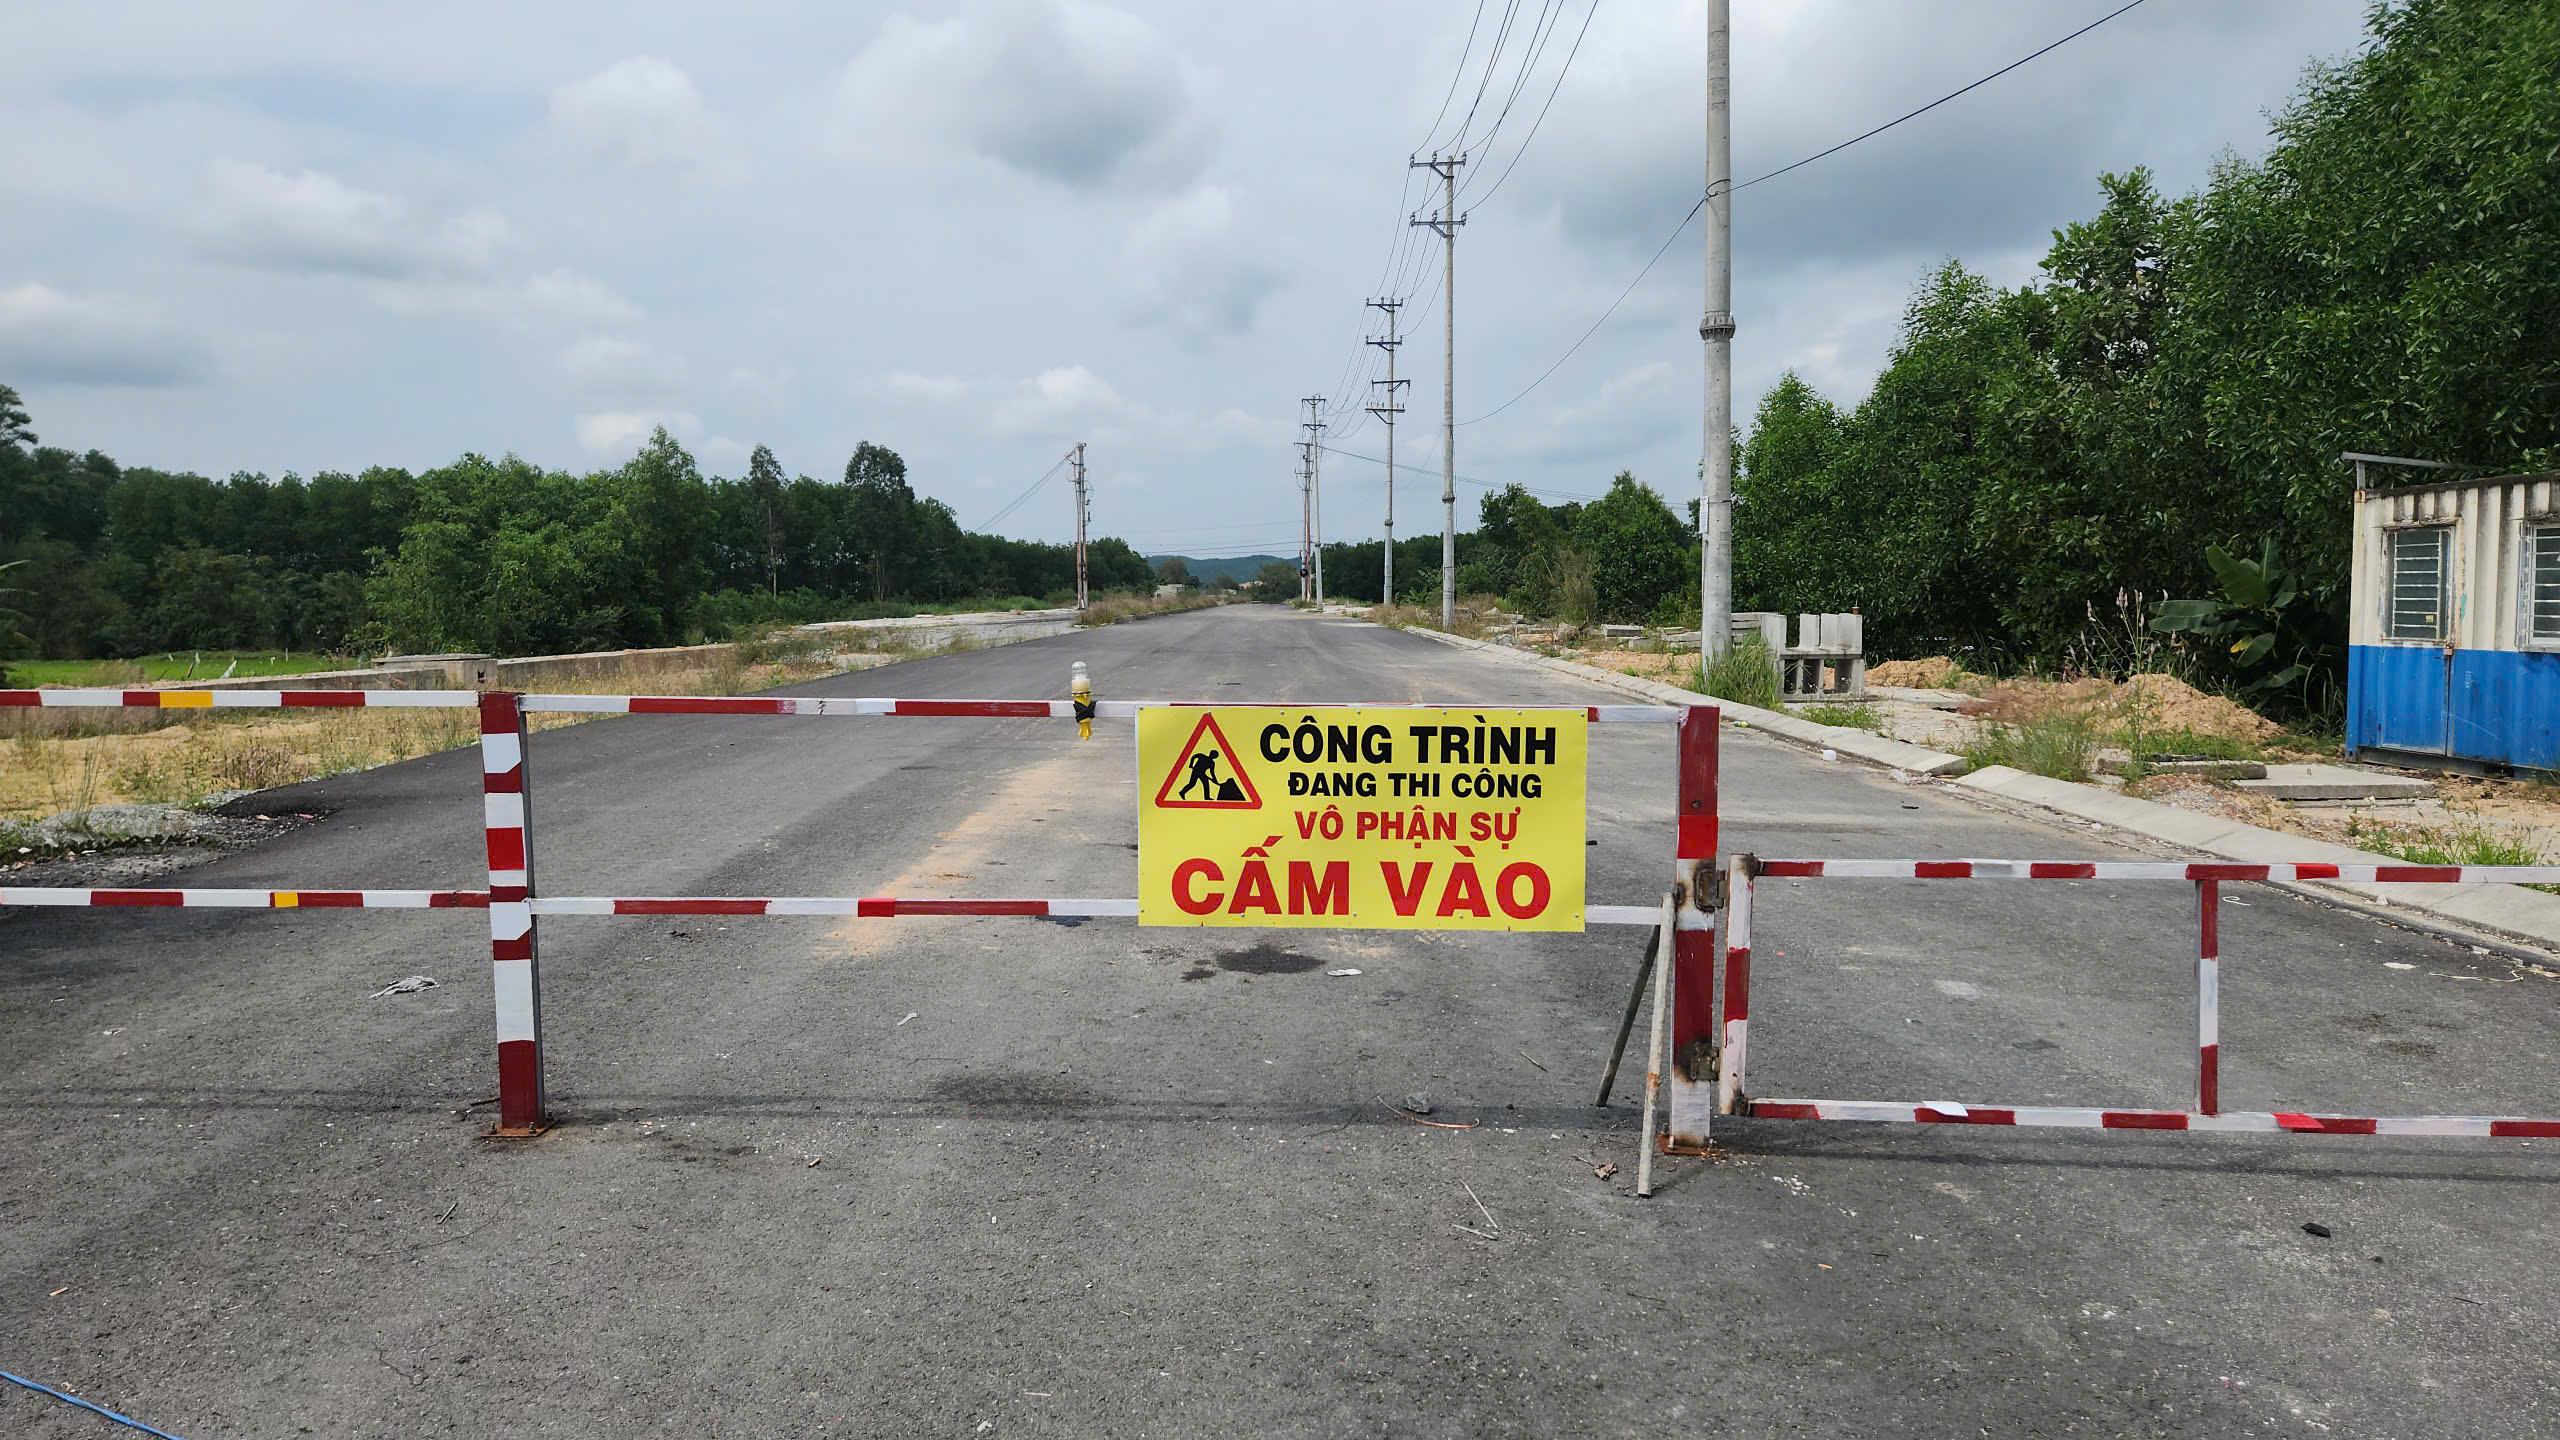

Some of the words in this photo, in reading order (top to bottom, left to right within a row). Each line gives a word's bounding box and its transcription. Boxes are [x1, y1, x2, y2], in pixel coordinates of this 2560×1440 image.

[1259, 715, 1393, 764] CÔNG
[1410, 714, 1557, 765] TRÌNH
[1288, 772, 1376, 798] ĐANG
[1388, 772, 1441, 798] THI
[1451, 768, 1542, 799] CÔNG
[1294, 804, 1344, 841] VÔ
[1357, 804, 1457, 849] PHẬN
[1469, 806, 1521, 850] SỰ
[1171, 835, 1350, 916] CẤM
[1379, 845, 1551, 919] VÀO
